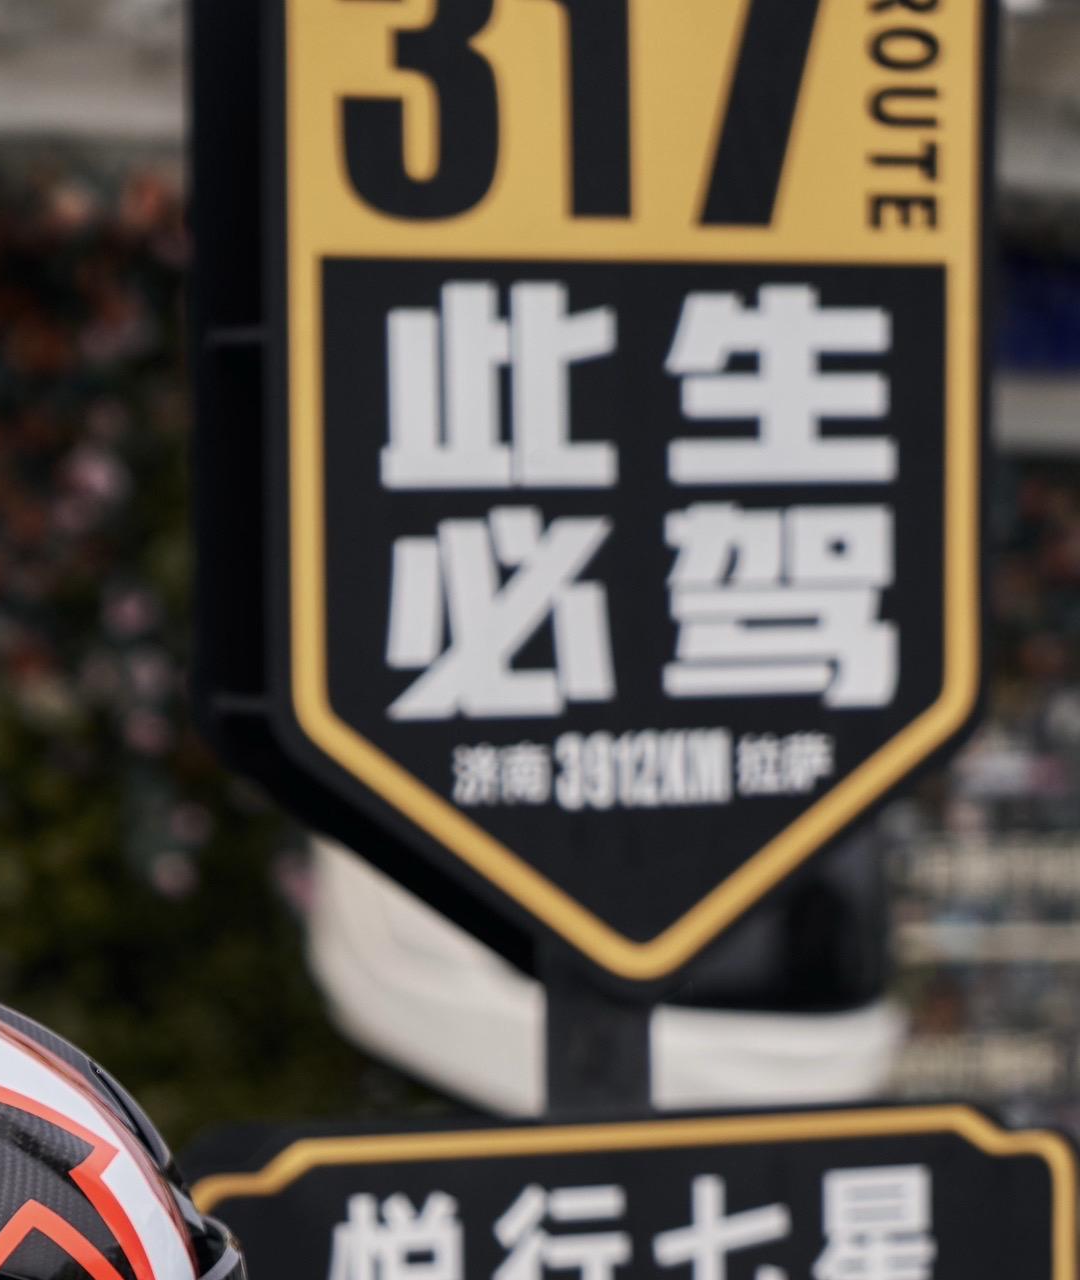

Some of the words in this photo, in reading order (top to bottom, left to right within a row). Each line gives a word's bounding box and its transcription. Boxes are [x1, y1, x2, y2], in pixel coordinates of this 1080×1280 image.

[380, 280, 898, 489] 此生
[385, 504, 898, 721] 必驾
[452, 741, 552, 806] 济南
[555, 726, 732, 811] 3912KM
[736, 731, 834, 796] 拉萨
